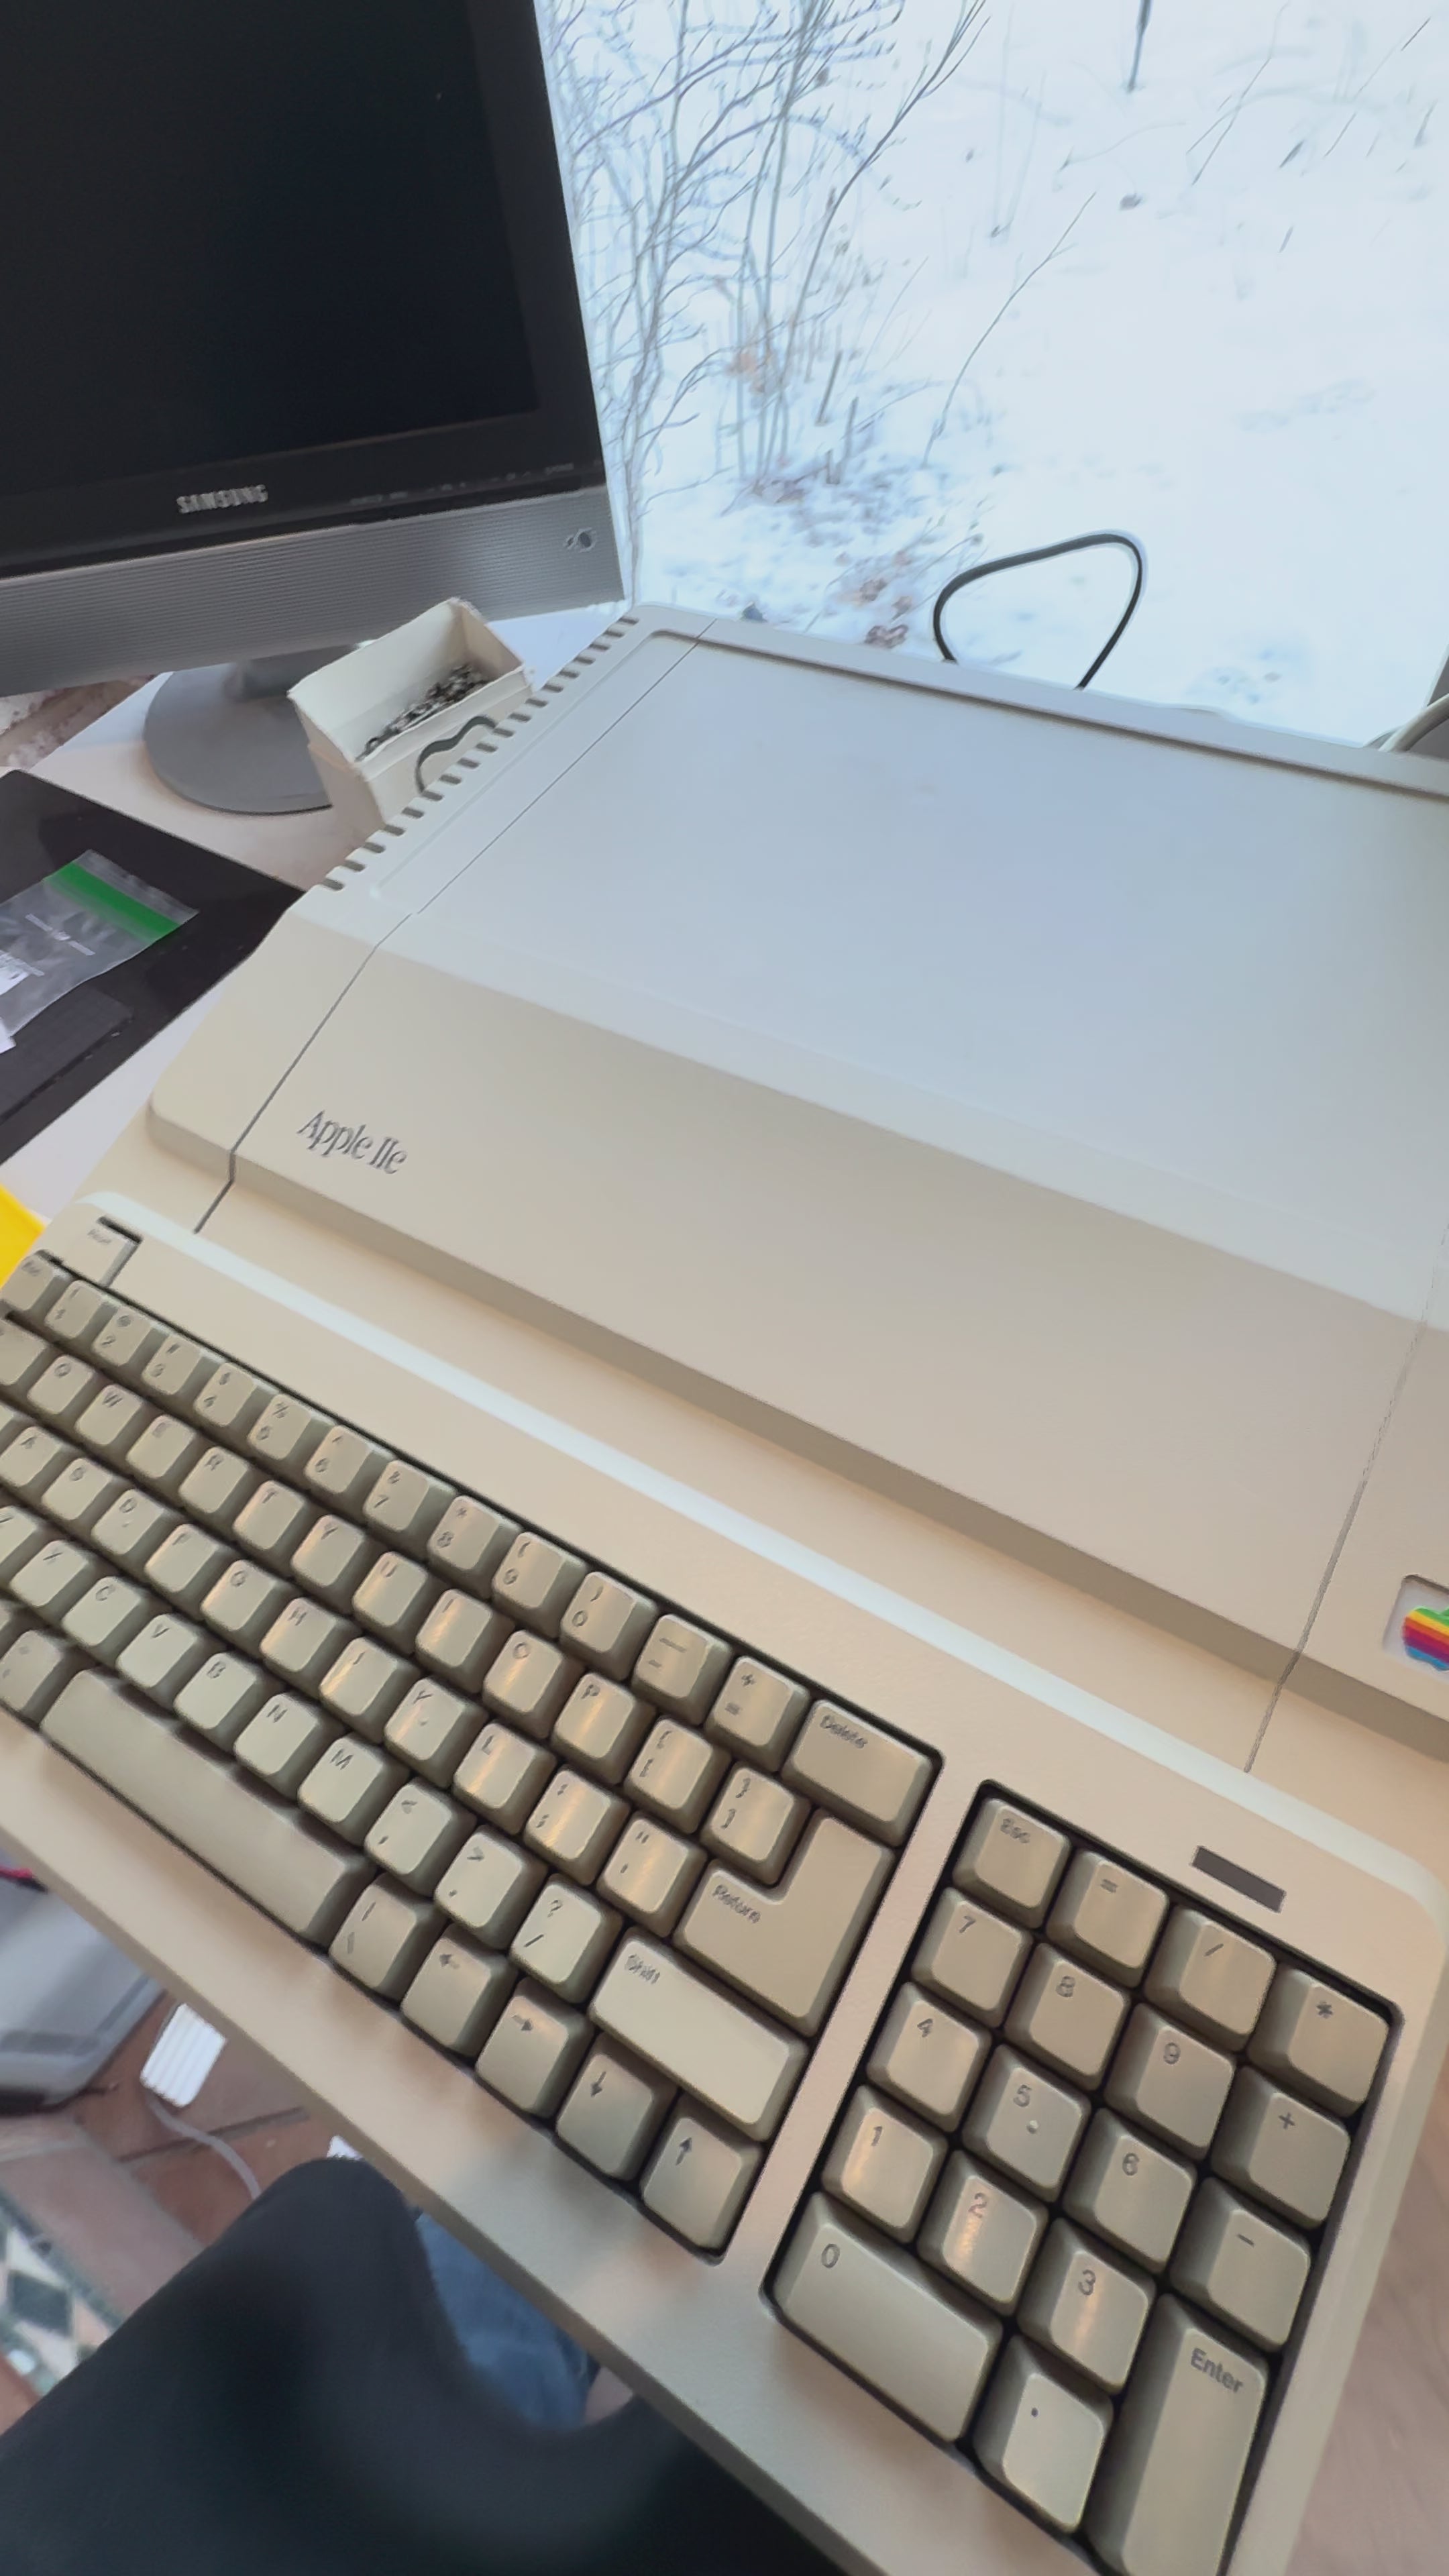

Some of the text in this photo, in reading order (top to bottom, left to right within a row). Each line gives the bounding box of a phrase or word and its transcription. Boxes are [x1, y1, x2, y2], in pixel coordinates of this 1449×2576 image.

[176, 484, 268, 514] SAMSUNG
[297, 1110, 374, 1159] Apple
[513, 1642, 531, 1659] O
[581, 1683, 600, 1700] P
[820, 1714, 868, 1748] Delete
[329, 1748, 354, 1770] M
[712, 1882, 762, 1924] Return
[959, 1915, 977, 1934] 7
[1055, 1975, 1076, 1998] 8
[917, 2018, 933, 2038] 4
[1163, 2042, 1181, 2065] 9
[1013, 2084, 1032, 2108] 5
[871, 2126, 882, 2146] 1
[1122, 2153, 1140, 2176] 6
[968, 2192, 987, 2218] 2
[821, 2243, 841, 2269] 0
[1077, 2269, 1097, 2297] 3
[1190, 2347, 1244, 2393] Enter
